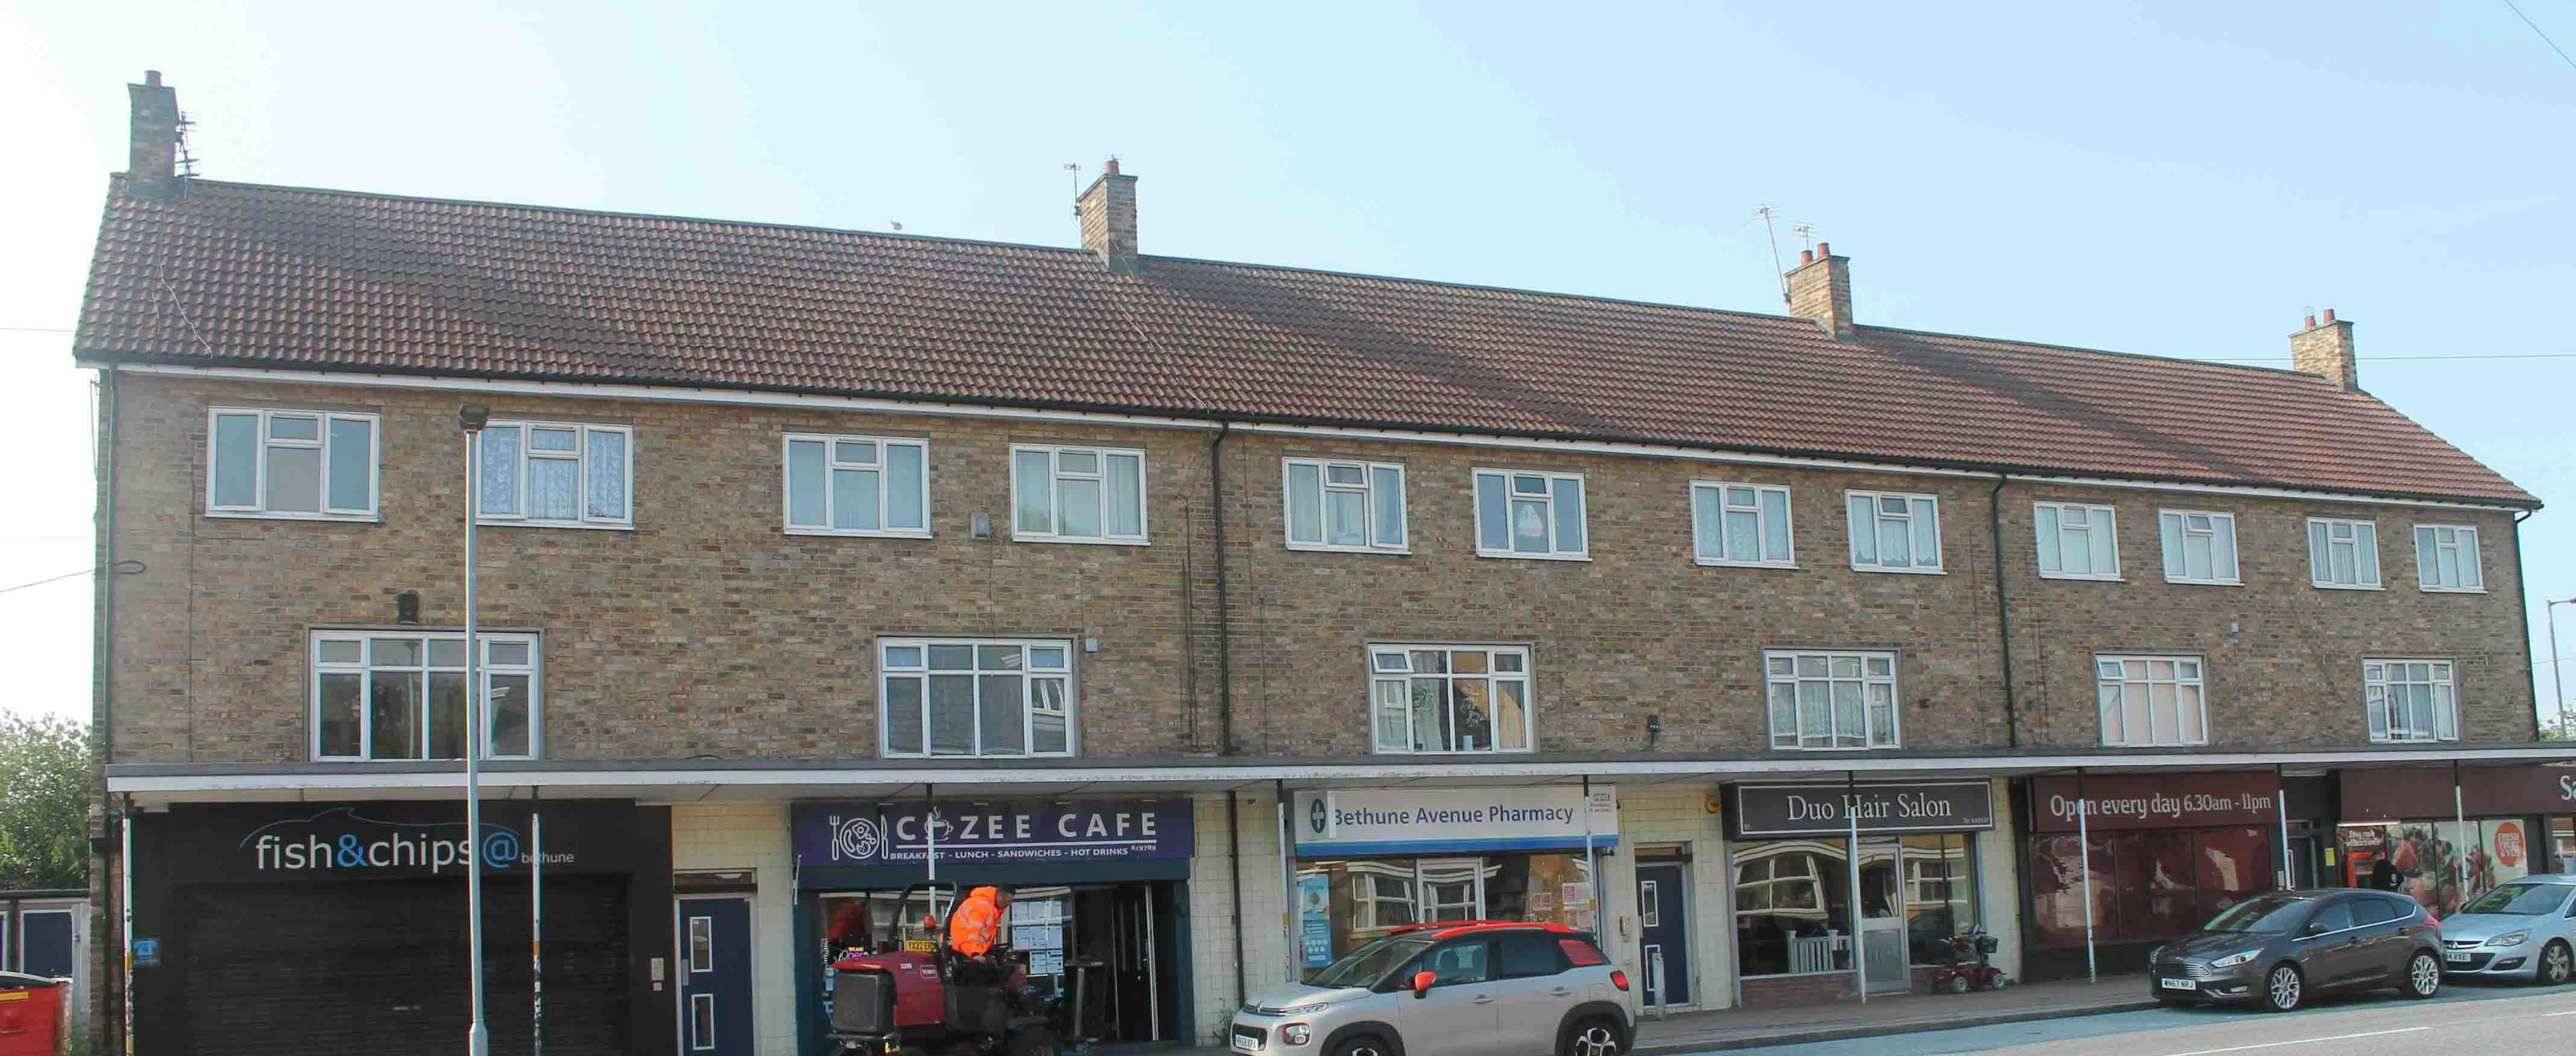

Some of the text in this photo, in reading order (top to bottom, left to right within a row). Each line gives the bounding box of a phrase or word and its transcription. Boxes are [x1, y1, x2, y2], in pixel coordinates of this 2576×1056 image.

[1335, 808, 1409, 825] Bethune
[1416, 807, 1482, 823] Avenue
[1489, 805, 1573, 824] Pharmacy
[1785, 792, 1952, 820] Duo Hair Salon
[2102, 798, 2147, 819] every
[2151, 792, 2181, 818] day
[2184, 794, 2232, 811] 6.30am
[2242, 793, 2272, 813] 11pm
[897, 813, 1157, 841] CZEE CAFE
[522, 851, 573, 864] bhune
[890, 852, 945, 860] BREAKFST
[997, 849, 1061, 858] SANDWICHES
[1093, 847, 1128, 856] DRINKS
